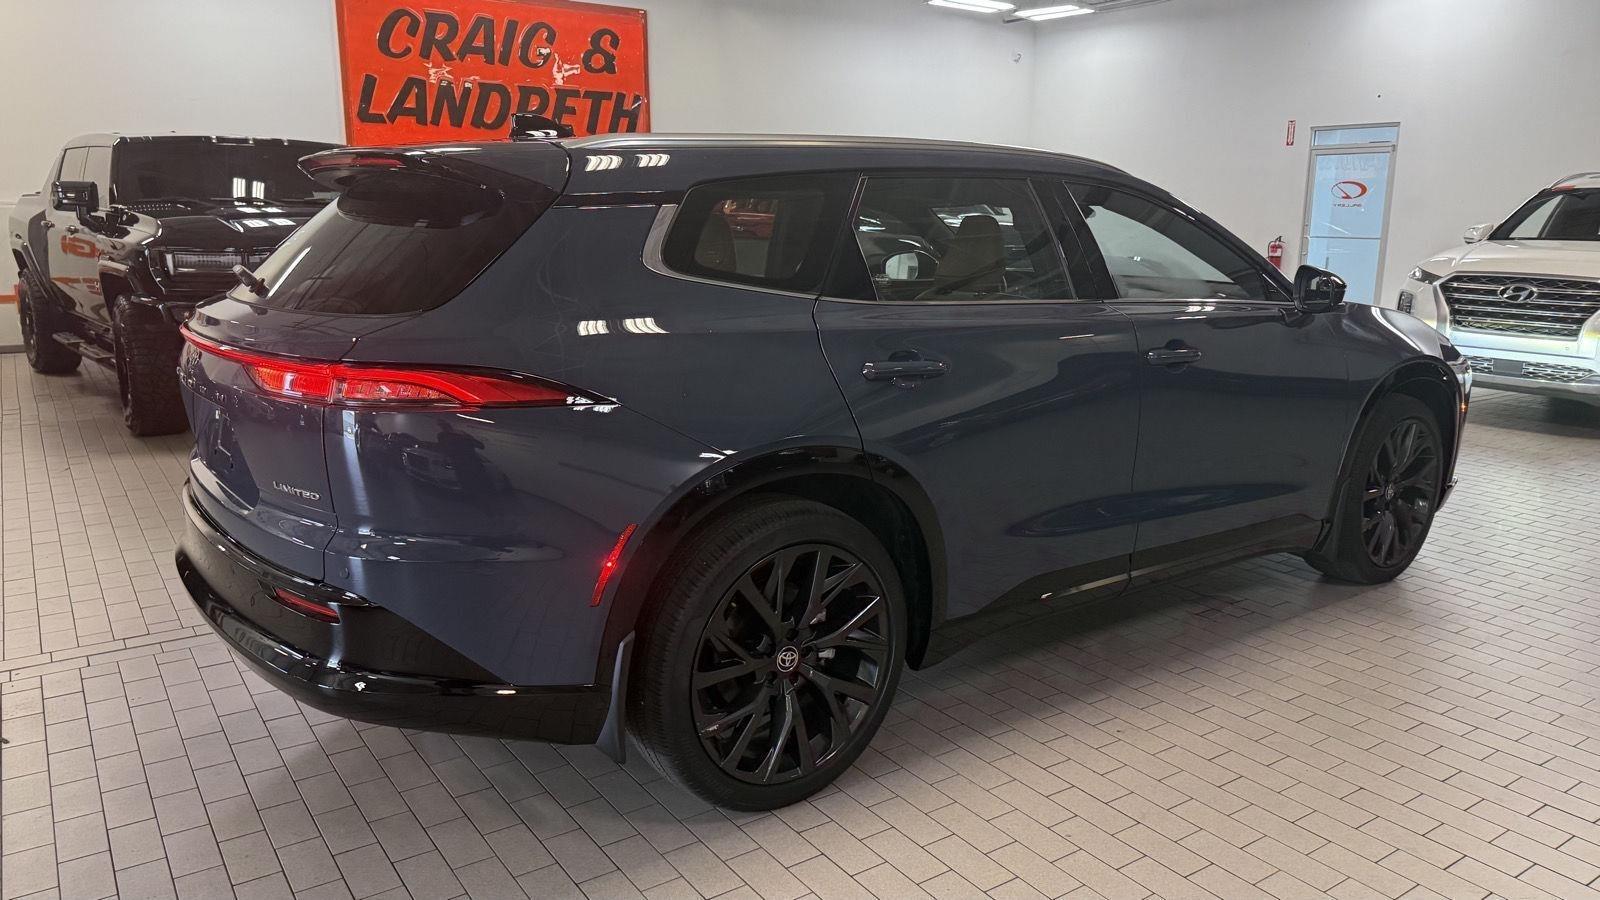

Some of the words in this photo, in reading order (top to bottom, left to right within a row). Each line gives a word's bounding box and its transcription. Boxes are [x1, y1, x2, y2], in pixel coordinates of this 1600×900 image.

[377, 8, 557, 69] CRAIG
[581, 28, 620, 75] &
[272, 481, 321, 501] LIMITED
